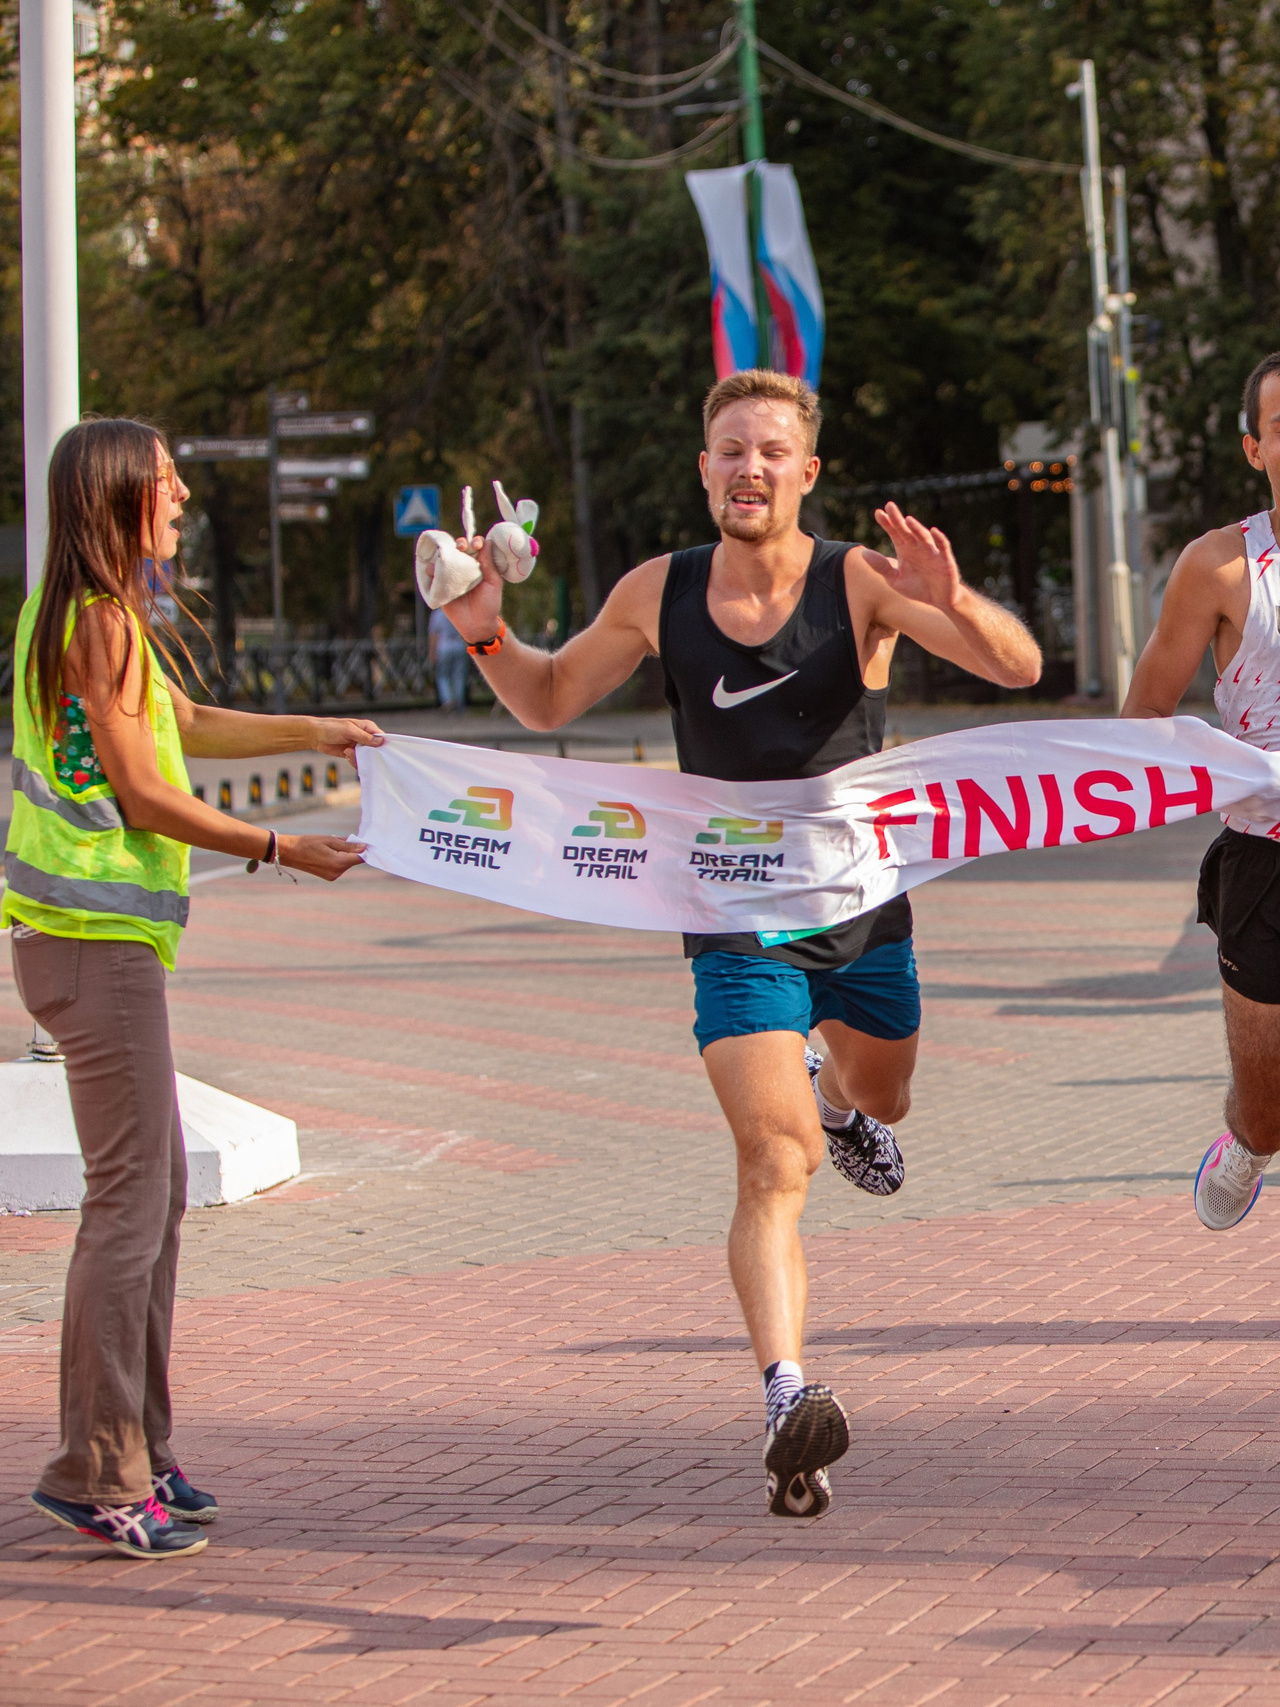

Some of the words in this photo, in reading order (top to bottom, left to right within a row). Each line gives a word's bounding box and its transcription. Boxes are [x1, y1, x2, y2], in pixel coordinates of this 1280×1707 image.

[864, 765, 1213, 860] FINISH
[419, 828, 512, 855] DREAM
[429, 845, 501, 870] TRAIL
[562, 845, 648, 864] DREAM
[688, 851, 785, 868] DREAM
[573, 862, 639, 880] TRAIL
[696, 867, 776, 882] TRAIL
